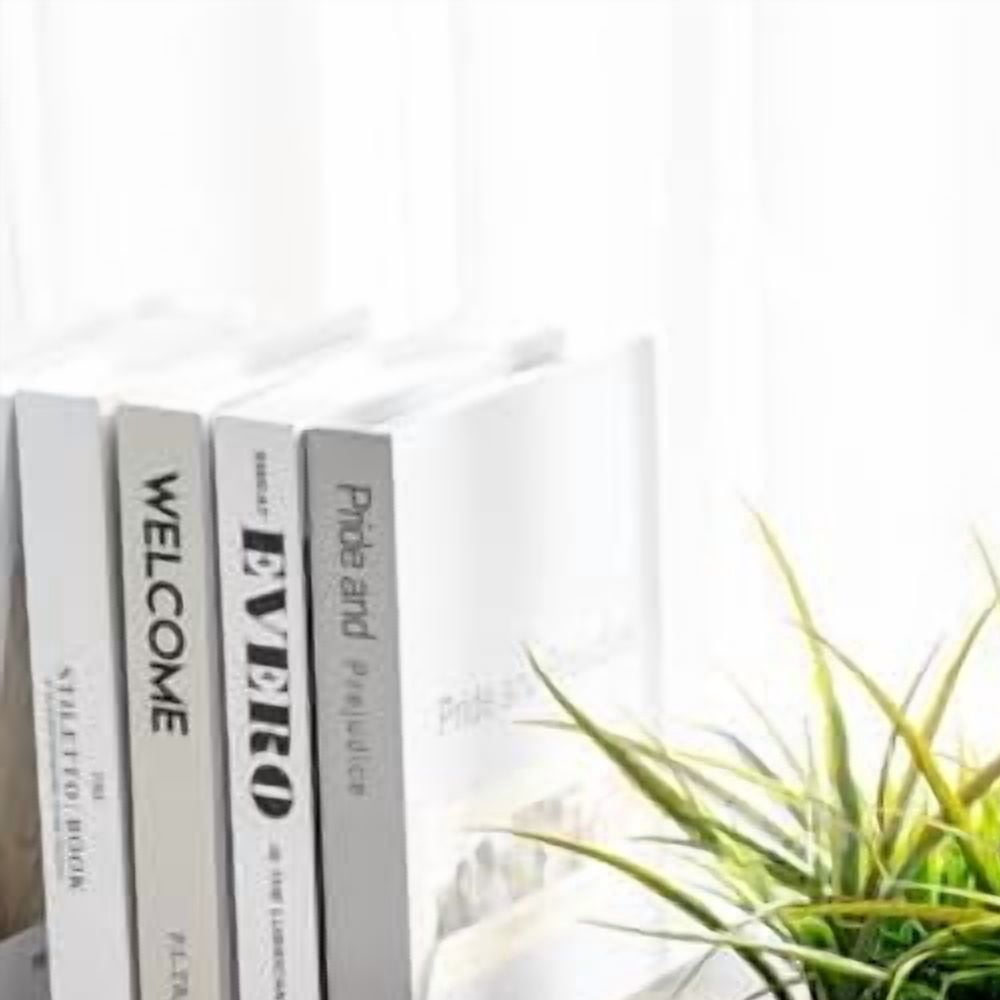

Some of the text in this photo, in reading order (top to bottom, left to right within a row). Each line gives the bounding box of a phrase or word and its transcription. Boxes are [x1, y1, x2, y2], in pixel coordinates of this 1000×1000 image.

[142, 470, 189, 737] WELCOME
[336, 482, 373, 569] Pride
[340, 575, 377, 641] and
[242, 529, 294, 820] EVERO
